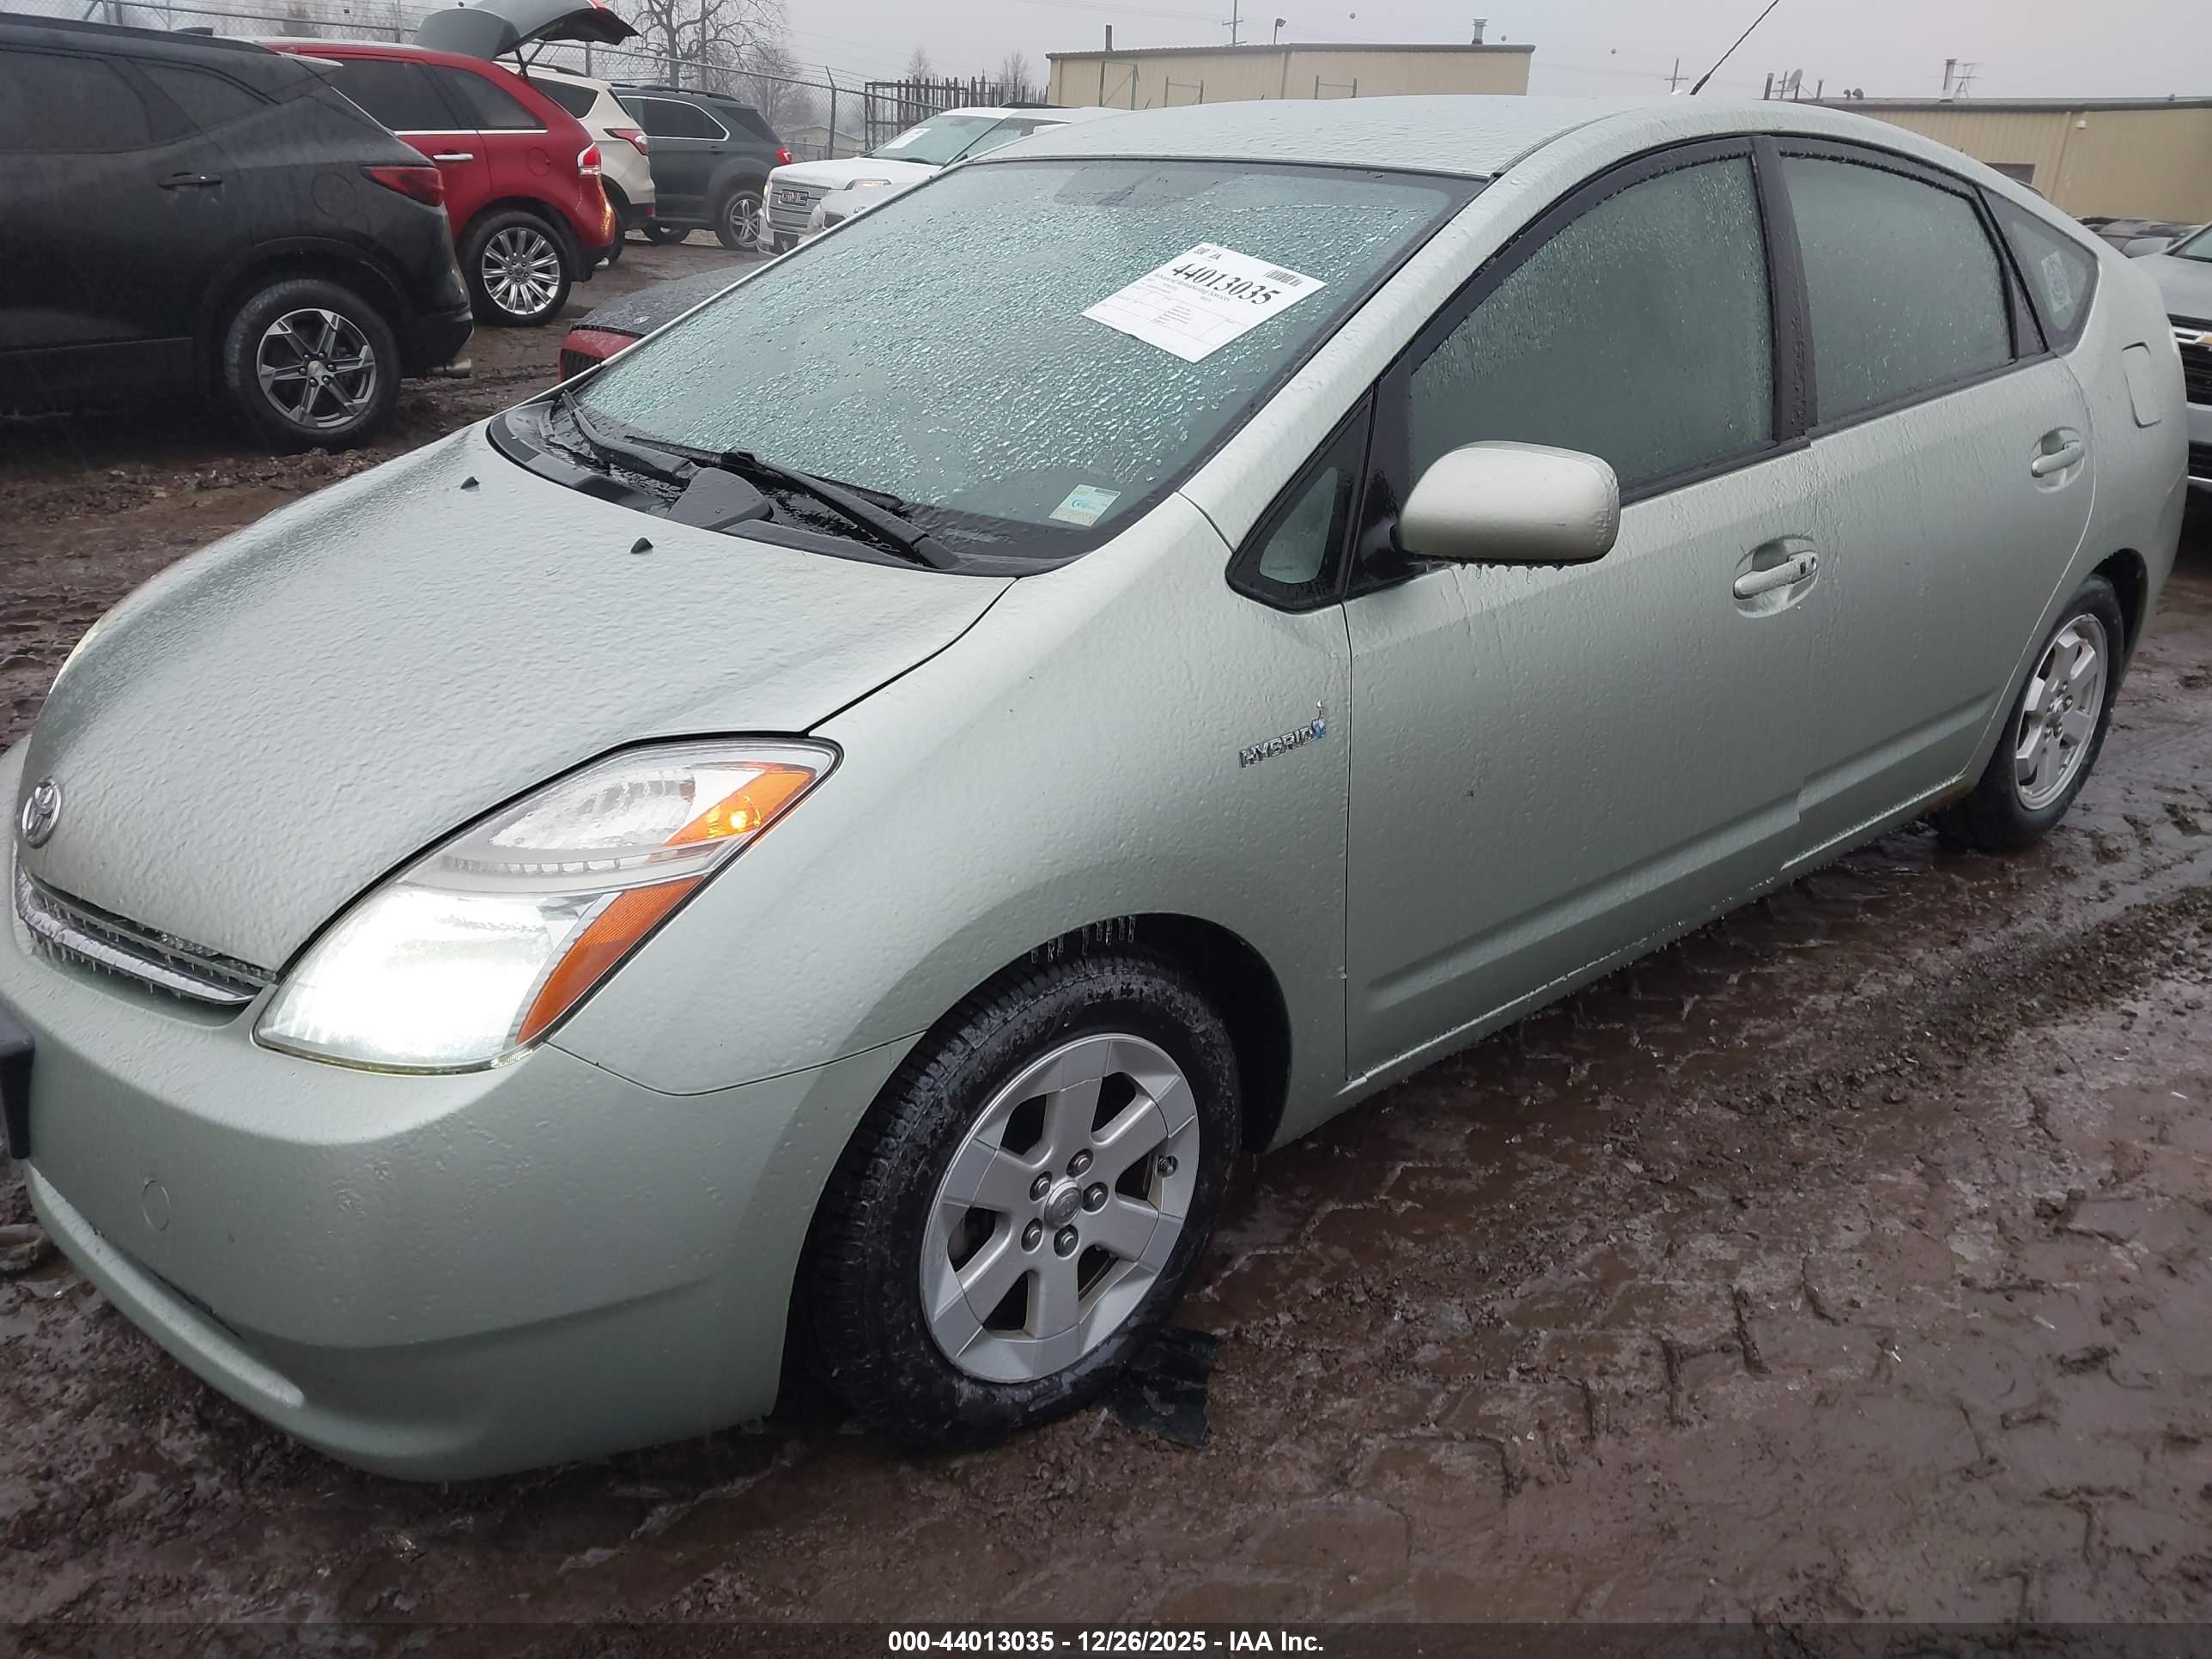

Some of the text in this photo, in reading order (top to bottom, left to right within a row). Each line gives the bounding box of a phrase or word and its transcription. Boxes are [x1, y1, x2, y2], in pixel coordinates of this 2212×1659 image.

[781, 191, 806, 204] GMC
[1171, 263, 1281, 305] 44013035
[1238, 726, 1314, 769] HYBRID
